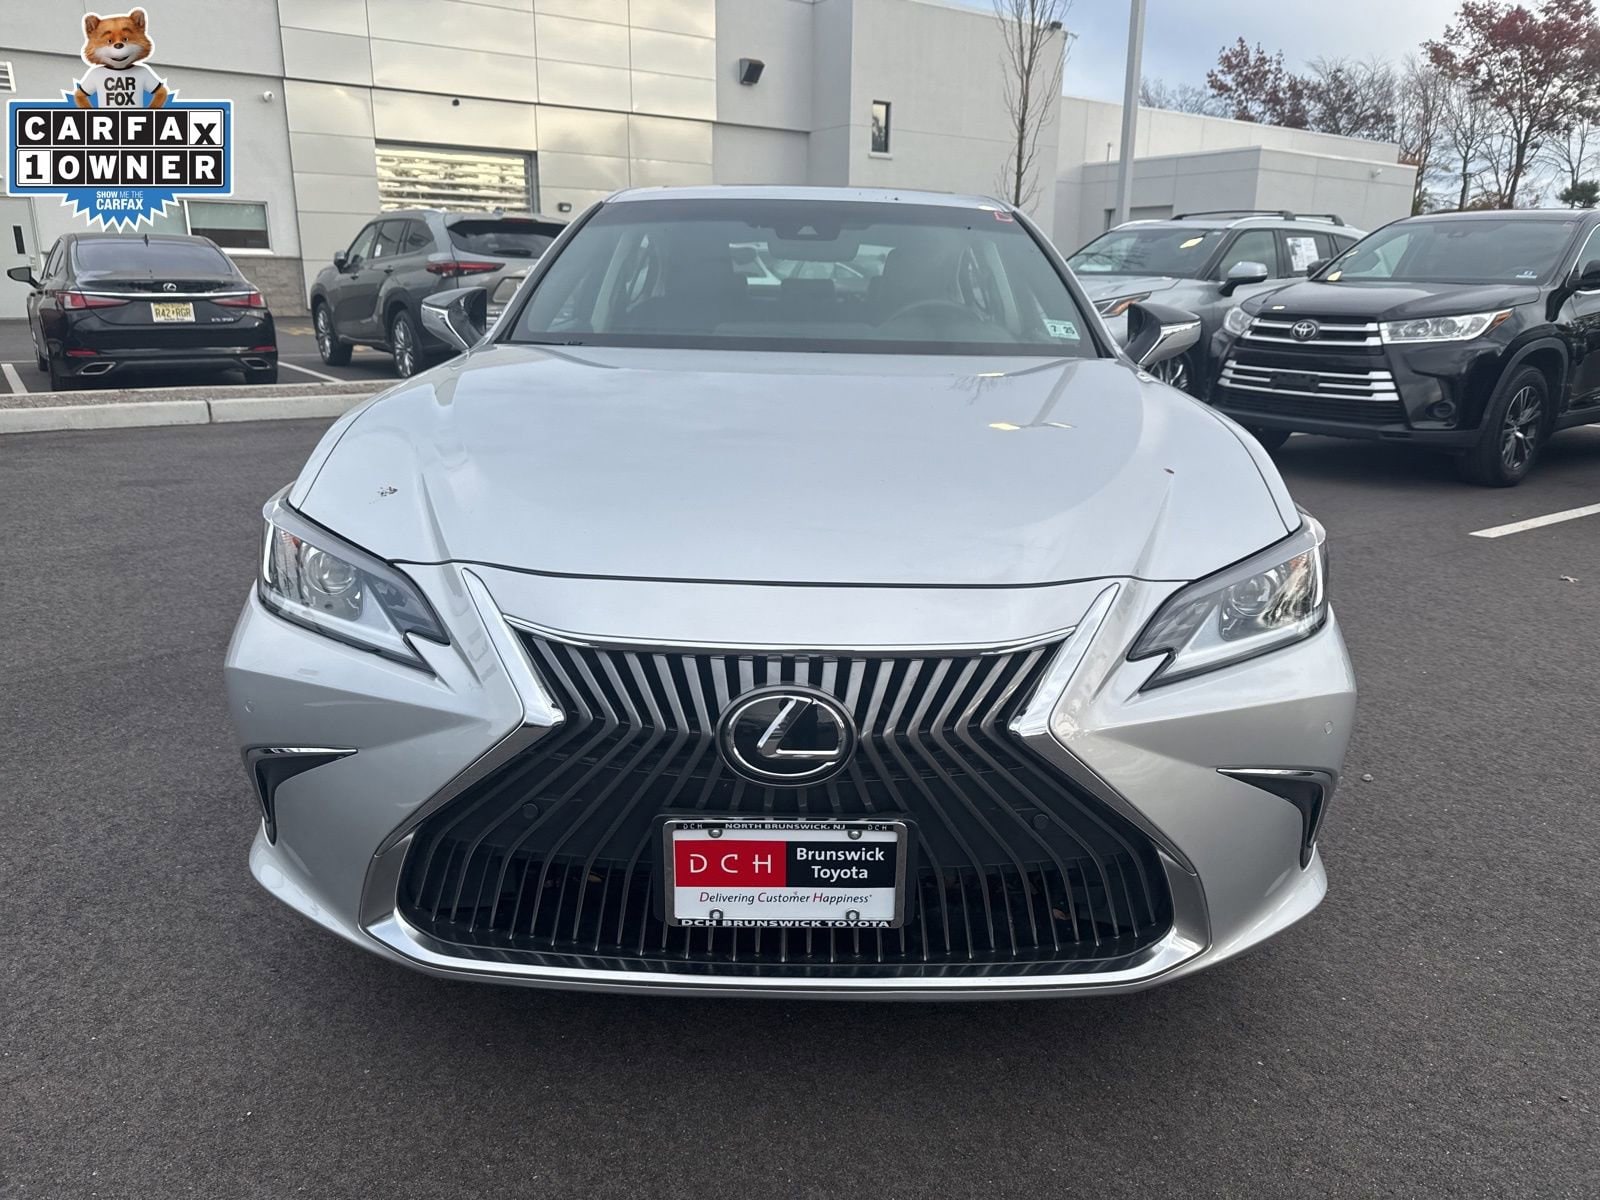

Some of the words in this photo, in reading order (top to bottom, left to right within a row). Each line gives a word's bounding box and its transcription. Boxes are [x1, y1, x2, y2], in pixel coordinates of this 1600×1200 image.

[796, 847, 885, 861] Brunswick
[811, 866, 868, 882] Toyota
[700, 891, 755, 905] Delivering
[757, 891, 810, 903] Customer
[681, 919, 717, 927] DCH
[722, 919, 822, 928] BRUNSWICK
[825, 920, 890, 928] TOYOTA
